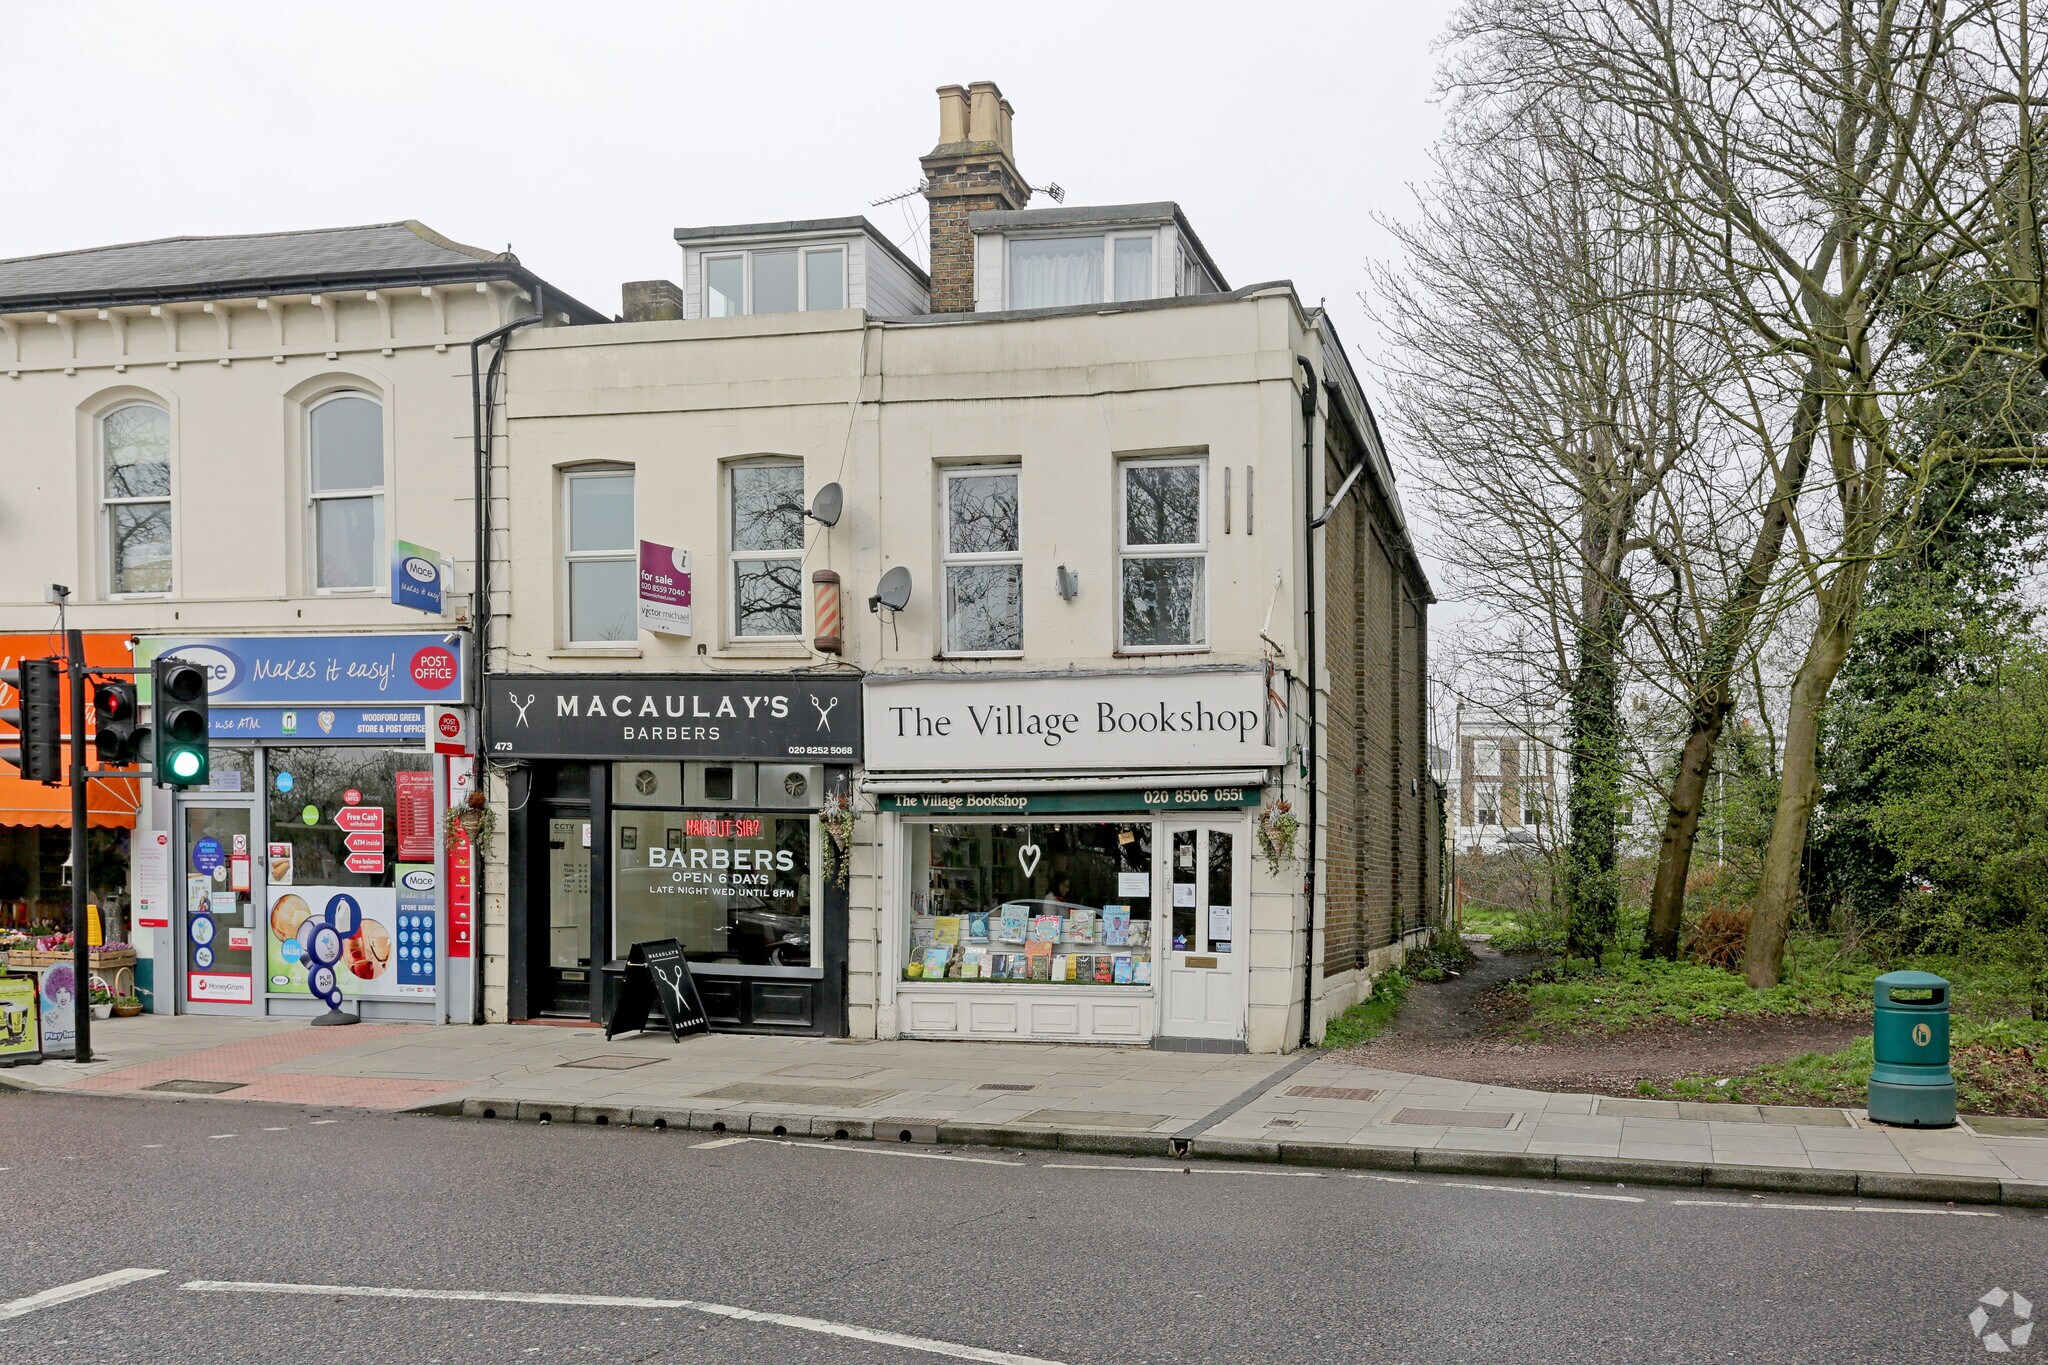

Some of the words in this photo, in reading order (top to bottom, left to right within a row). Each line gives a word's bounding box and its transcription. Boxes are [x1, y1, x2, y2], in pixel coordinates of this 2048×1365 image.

[409, 562, 433, 578] Mace
[641, 569, 653, 582] for
[655, 574, 673, 586] sale
[401, 582, 420, 595] Makes
[641, 582, 652, 591] 020
[652, 584, 667, 594] 8559
[668, 587, 685, 597] 7040
[641, 591, 676, 602] victormichael.com
[641, 604, 661, 618] victor
[662, 610, 689, 622] michael
[421, 656, 448, 667] POST
[207, 664, 228, 680] ce
[253, 658, 316, 682] Makes
[326, 658, 342, 681] it
[347, 653, 395, 691] easy!
[414, 668, 452, 679] OFFICE
[556, 695, 789, 718] MACAULAY'S
[215, 720, 235, 729] use
[237, 716, 261, 730] ATM
[362, 713, 399, 722] WOODFORD
[399, 713, 421, 722] GREEN
[443, 717, 456, 725] POST
[888, 706, 951, 737] The
[966, 704, 1079, 747] Village
[1097, 700, 1258, 743] Bookshop
[357, 725, 379, 733] STORE
[379, 725, 385, 733] &
[385, 724, 402, 733] POST
[403, 724, 426, 733] OFFICE
[440, 724, 458, 733] OFFICE
[623, 726, 720, 740] BARBERS
[494, 742, 513, 751] 473
[788, 746, 805, 754] 020
[806, 746, 829, 754] 8252
[830, 746, 853, 754] 5068
[362, 793, 383, 802] Money
[895, 794, 918, 807] The
[920, 794, 963, 810] Village
[966, 793, 1028, 809] Bookshop
[1144, 790, 1169, 804] 020
[1174, 789, 1209, 803] 8506
[1214, 788, 1244, 802] 0551
[346, 813, 361, 821] Free
[361, 812, 378, 821] Cash
[685, 819, 731, 837] HAIRCUT
[736, 819, 760, 837] SIR?
[649, 846, 795, 872] BARBERS
[409, 876, 433, 885] Mace
[672, 872, 713, 884] OPEN
[718, 873, 727, 884] 6
[732, 874, 769, 885] DAYS
[649, 886, 674, 894] LATE
[677, 887, 709, 895] NIGHT
[712, 888, 735, 896] WED
[738, 889, 770, 897] UNTIL
[772, 889, 795, 898] 8PM
[417, 904, 435, 912] SERVIC
[676, 1018, 704, 1030] BARBERS
[45, 1032, 62, 1041] Play
